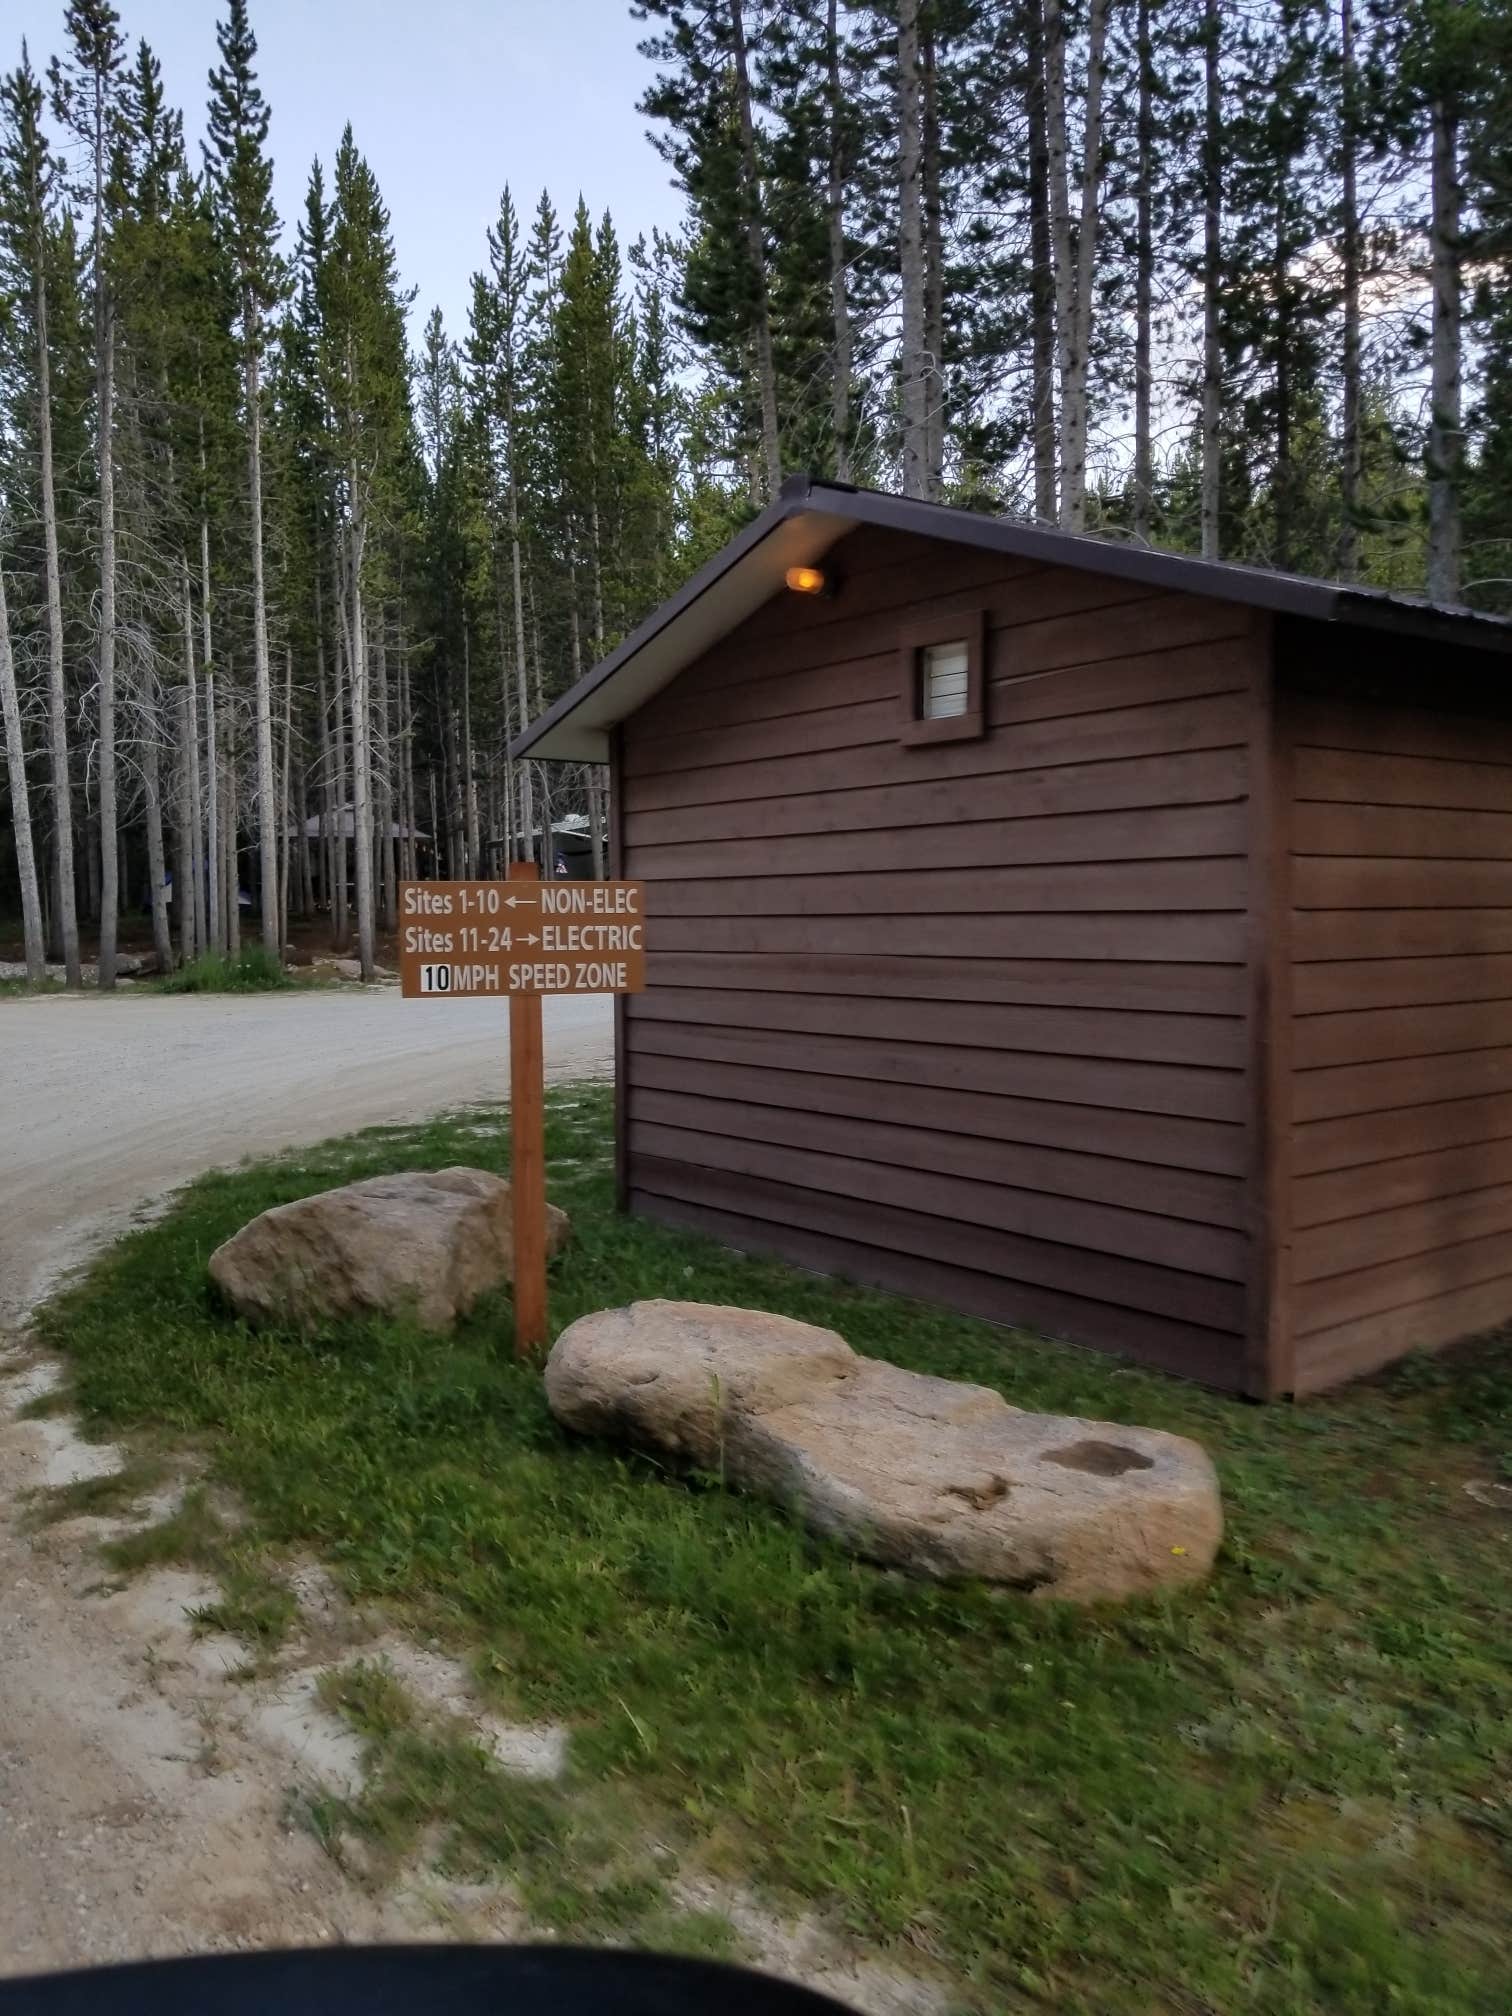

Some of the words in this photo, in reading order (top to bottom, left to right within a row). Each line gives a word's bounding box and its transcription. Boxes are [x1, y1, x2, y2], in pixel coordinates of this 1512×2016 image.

[404, 887, 452, 915] Sites
[459, 888, 500, 914] 1-10
[541, 888, 638, 914] NON-ELEC
[405, 926, 454, 953] Sites
[459, 926, 513, 952] 11-24
[542, 925, 643, 951] ELECTRIC
[509, 963, 571, 990] SPEED
[575, 962, 627, 989] ZONE
